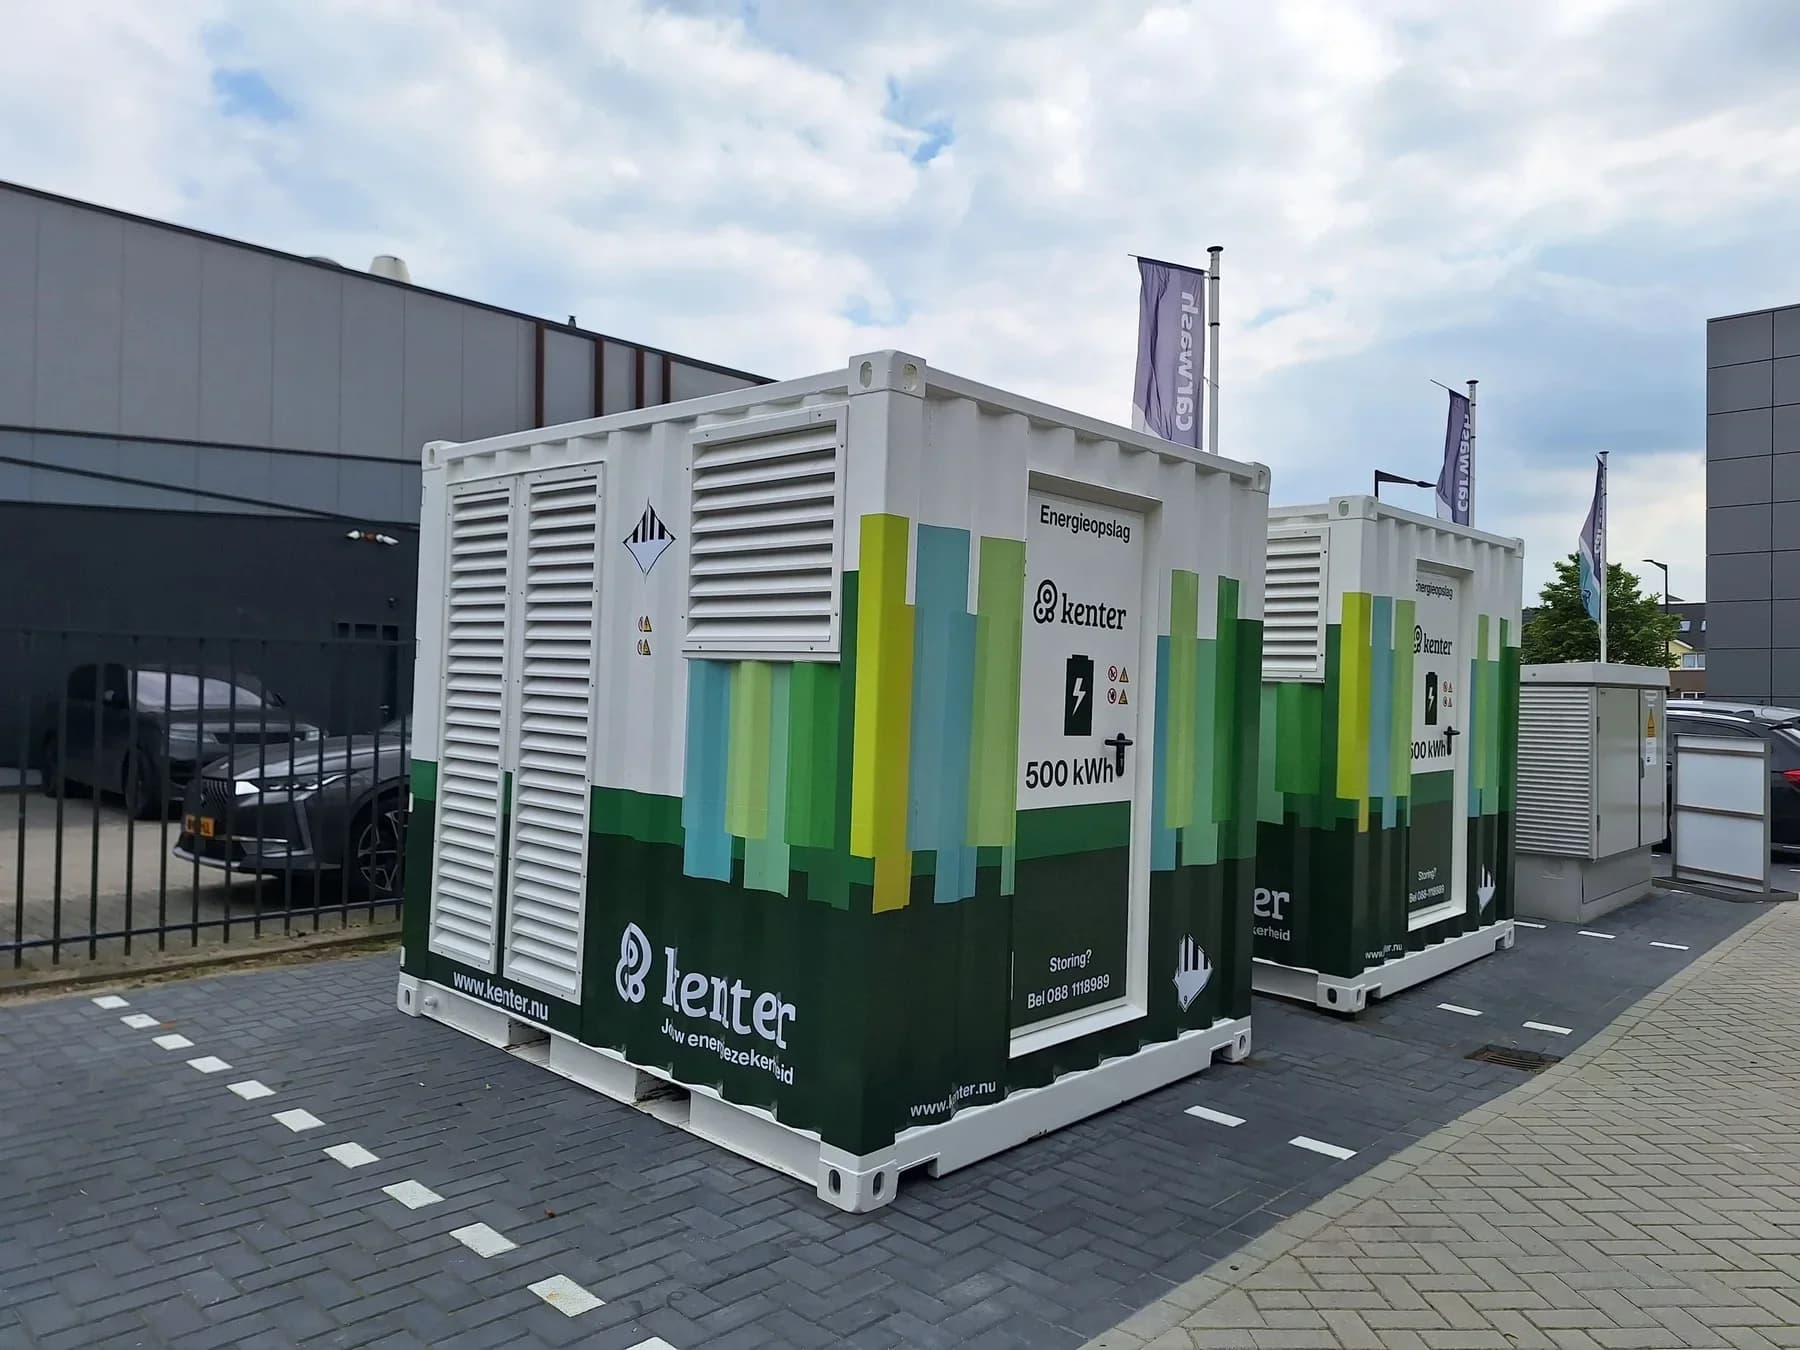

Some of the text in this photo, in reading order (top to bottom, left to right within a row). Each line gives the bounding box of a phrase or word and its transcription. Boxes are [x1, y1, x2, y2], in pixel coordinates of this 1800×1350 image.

[1040, 504, 1131, 544] Energieopslag
[1060, 592, 1127, 630] kenter
[1423, 632, 1453, 656] kenter
[1428, 739, 1446, 759] kWh
[1025, 757, 1113, 789] 500 kWh
[1049, 948, 1092, 973] Storing?
[453, 971, 549, 1021] www.kenter.nu
[662, 946, 796, 1049] kenter
[1027, 974, 1110, 1009] Bel 088 1118989
[910, 1080, 996, 1118] www.knter.nu
